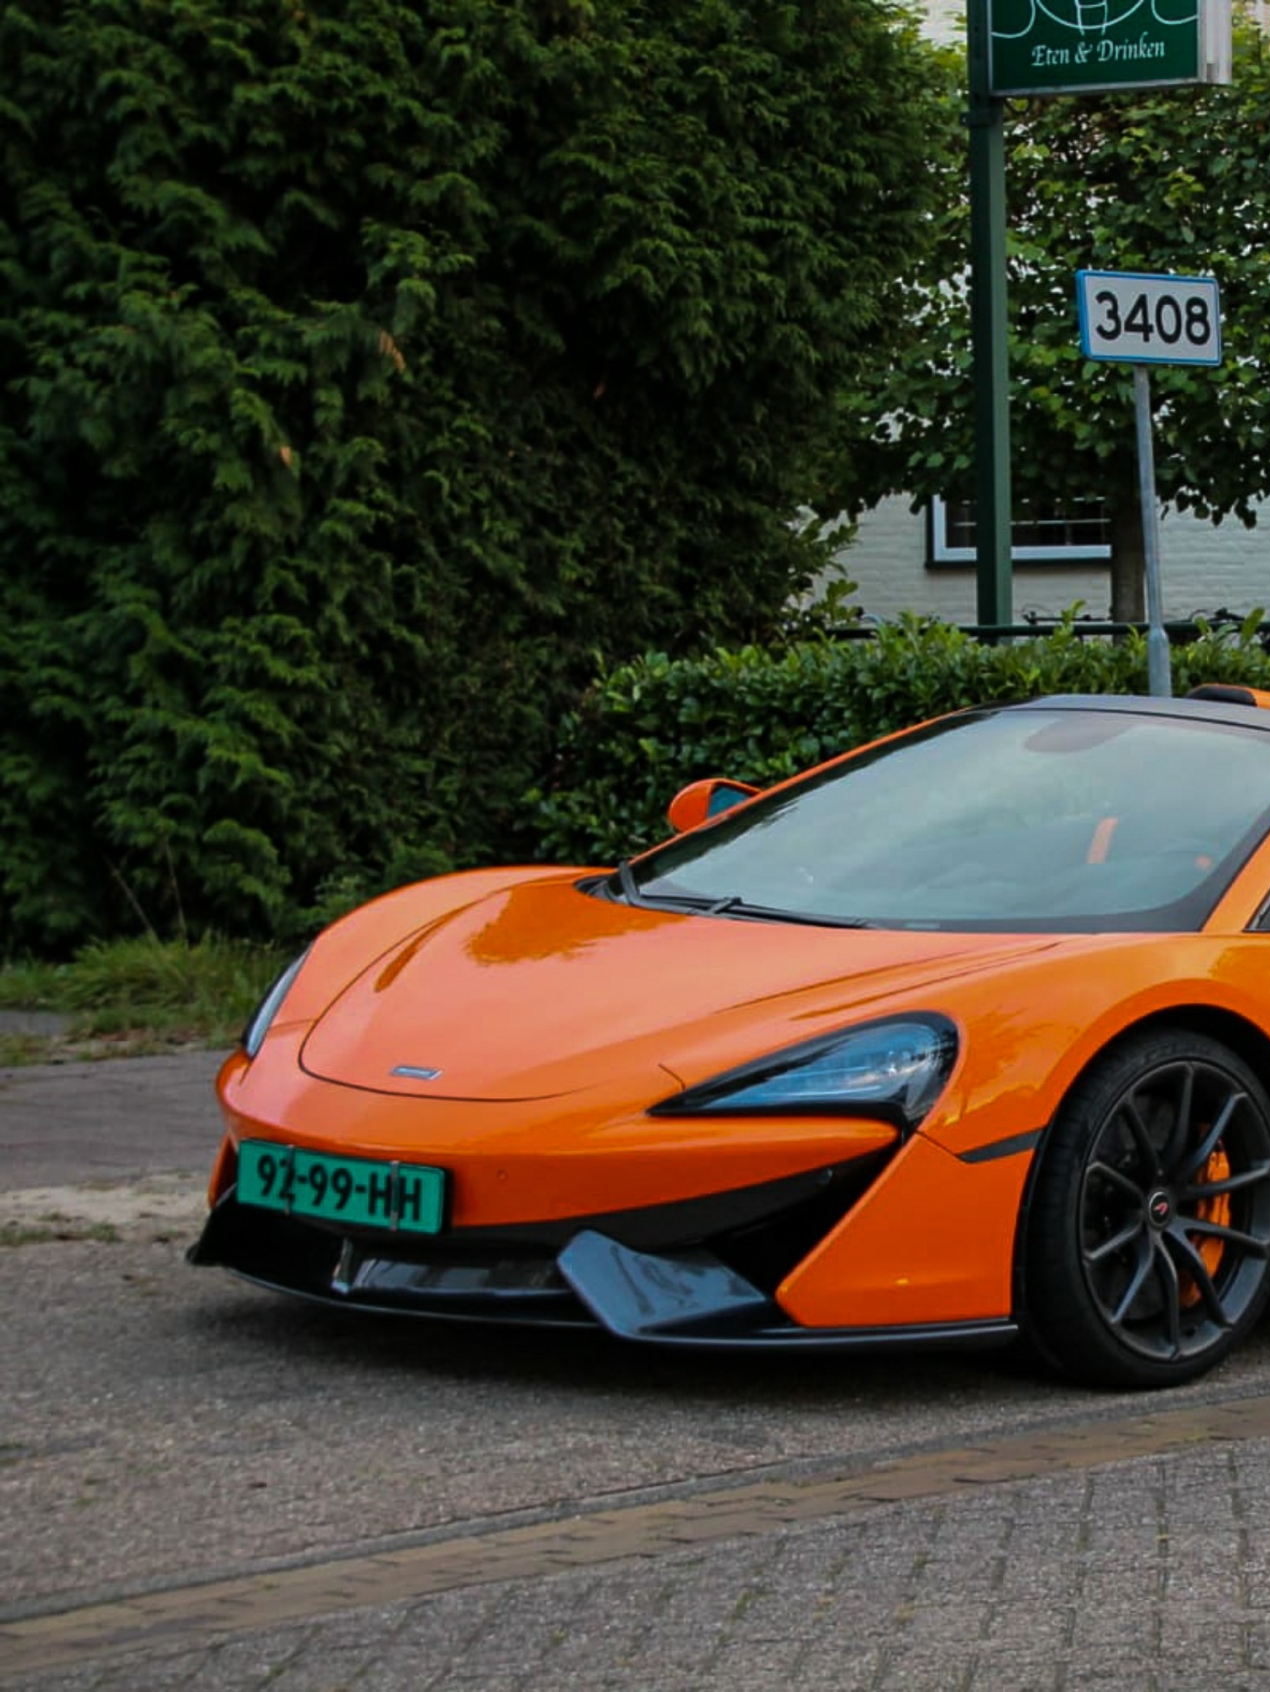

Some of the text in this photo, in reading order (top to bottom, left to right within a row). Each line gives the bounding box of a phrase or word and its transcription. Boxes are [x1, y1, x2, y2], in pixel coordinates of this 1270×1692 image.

[1031, 31, 1165, 66] Eten & Drinken
[1095, 290, 1211, 345] 3408
[257, 1154, 421, 1222] 92-99-HH
